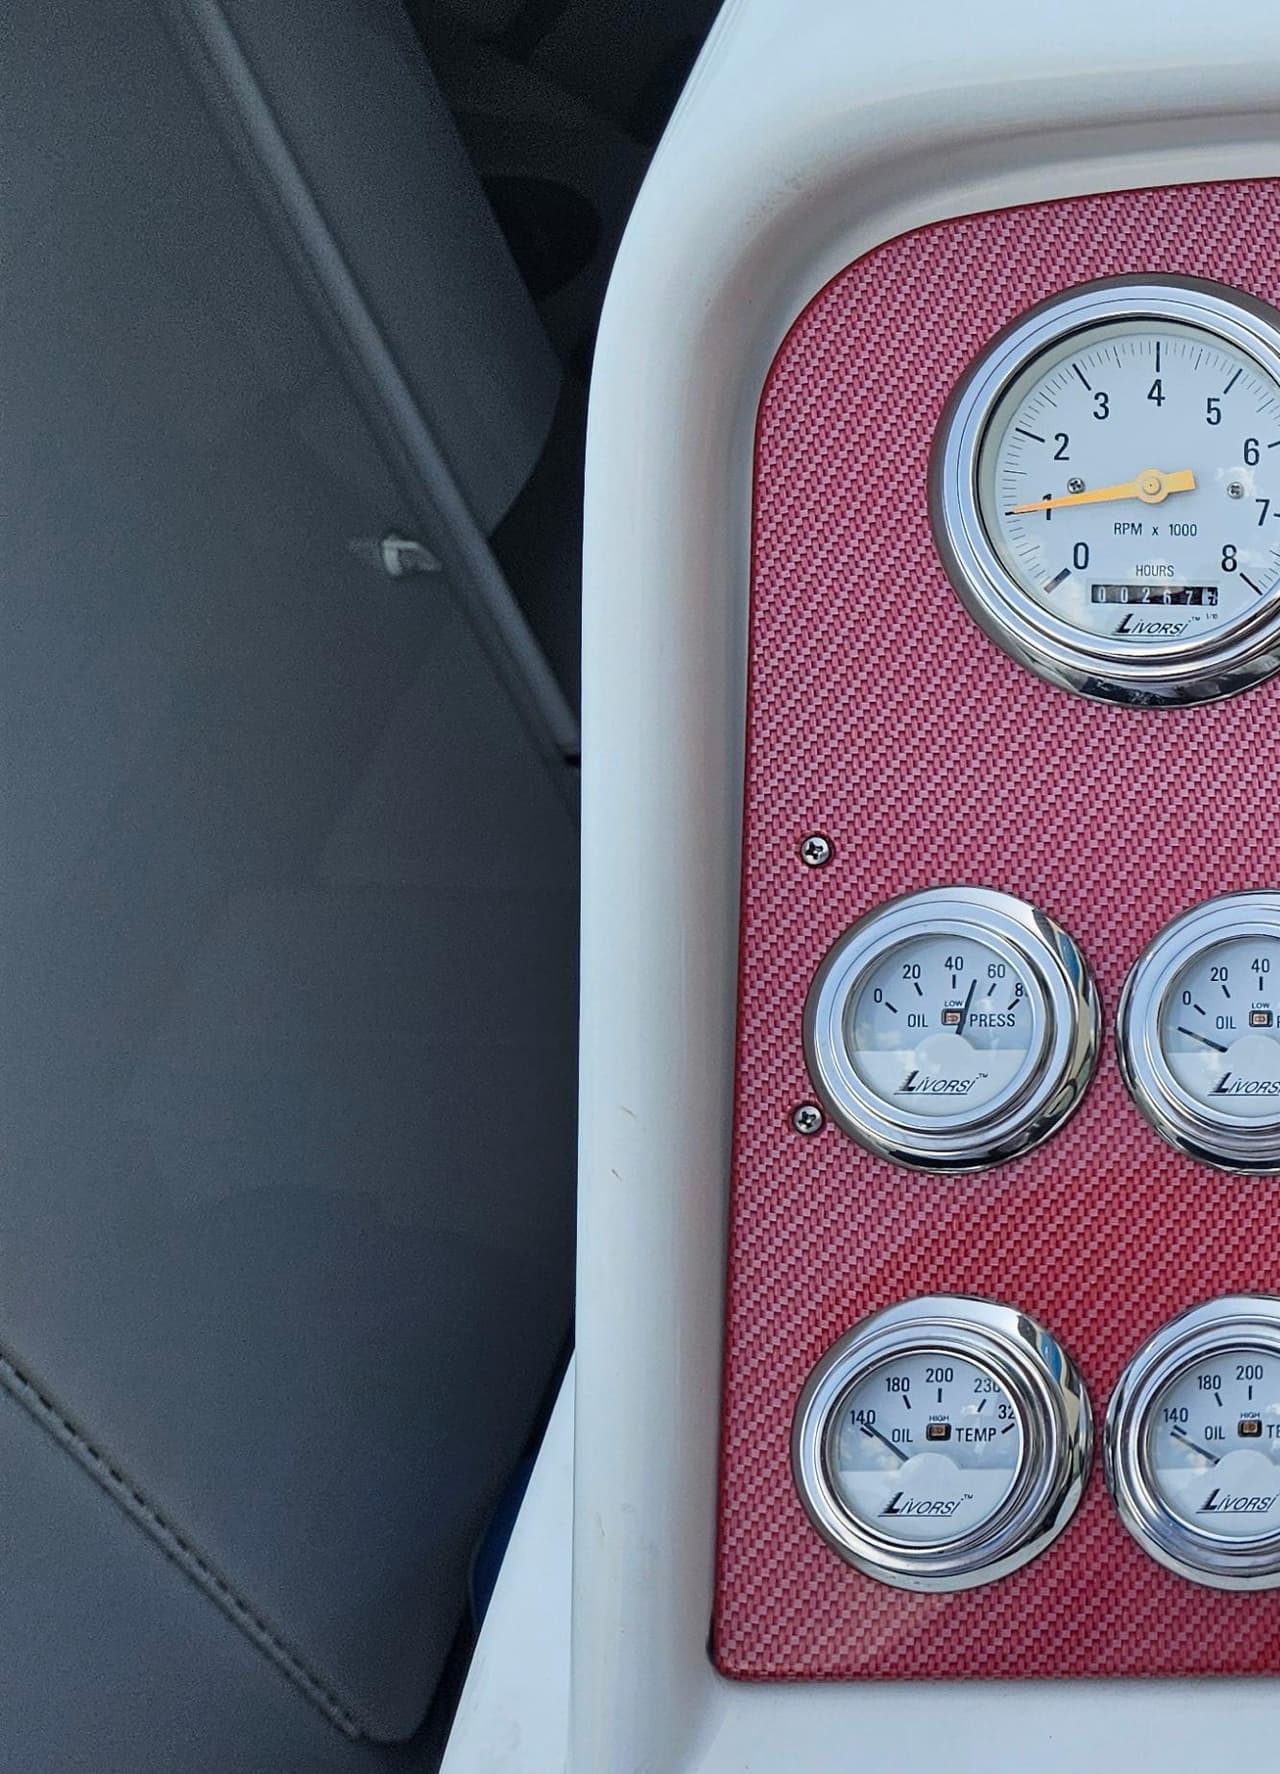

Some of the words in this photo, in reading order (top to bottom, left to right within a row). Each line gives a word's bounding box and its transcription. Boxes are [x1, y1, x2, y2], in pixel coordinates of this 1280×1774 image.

[1148, 379, 1165, 406] 4
[1093, 392, 1110, 420] 3
[1206, 398, 1221, 425] 5
[1054, 433, 1070, 461] 2
[1243, 438, 1260, 465] 6
[1255, 499, 1270, 526] 7
[1114, 523, 1143, 536] RPM
[1168, 524, 1197, 537] 1000
[1073, 543, 1089, 569] 0
[1222, 545, 1237, 572] 8
[1136, 565, 1174, 577] HOURS
[944, 956, 964, 971] 40
[987, 964, 1005, 978] 60
[1251, 958, 1270, 973] 40
[902, 964, 921, 979] 20
[1210, 967, 1228, 982] 20
[873, 988, 882, 1003] 0
[1182, 990, 1191, 1006] 0
[907, 1014, 928, 1028] OIL
[969, 1014, 1015, 1027] PRESS
[1215, 1015, 1236, 1030] OIL
[925, 1368, 954, 1383] 200
[1236, 1365, 1263, 1380] 200
[885, 1377, 910, 1392] 180
[974, 1378, 1001, 1393] 230
[1198, 1375, 1221, 1390] 180
[850, 1410, 875, 1425] 140
[1163, 1407, 1188, 1423] 140
[891, 1428, 913, 1443] OIL
[956, 1428, 997, 1442] TEMP
[1204, 1426, 1225, 1440] OIL
